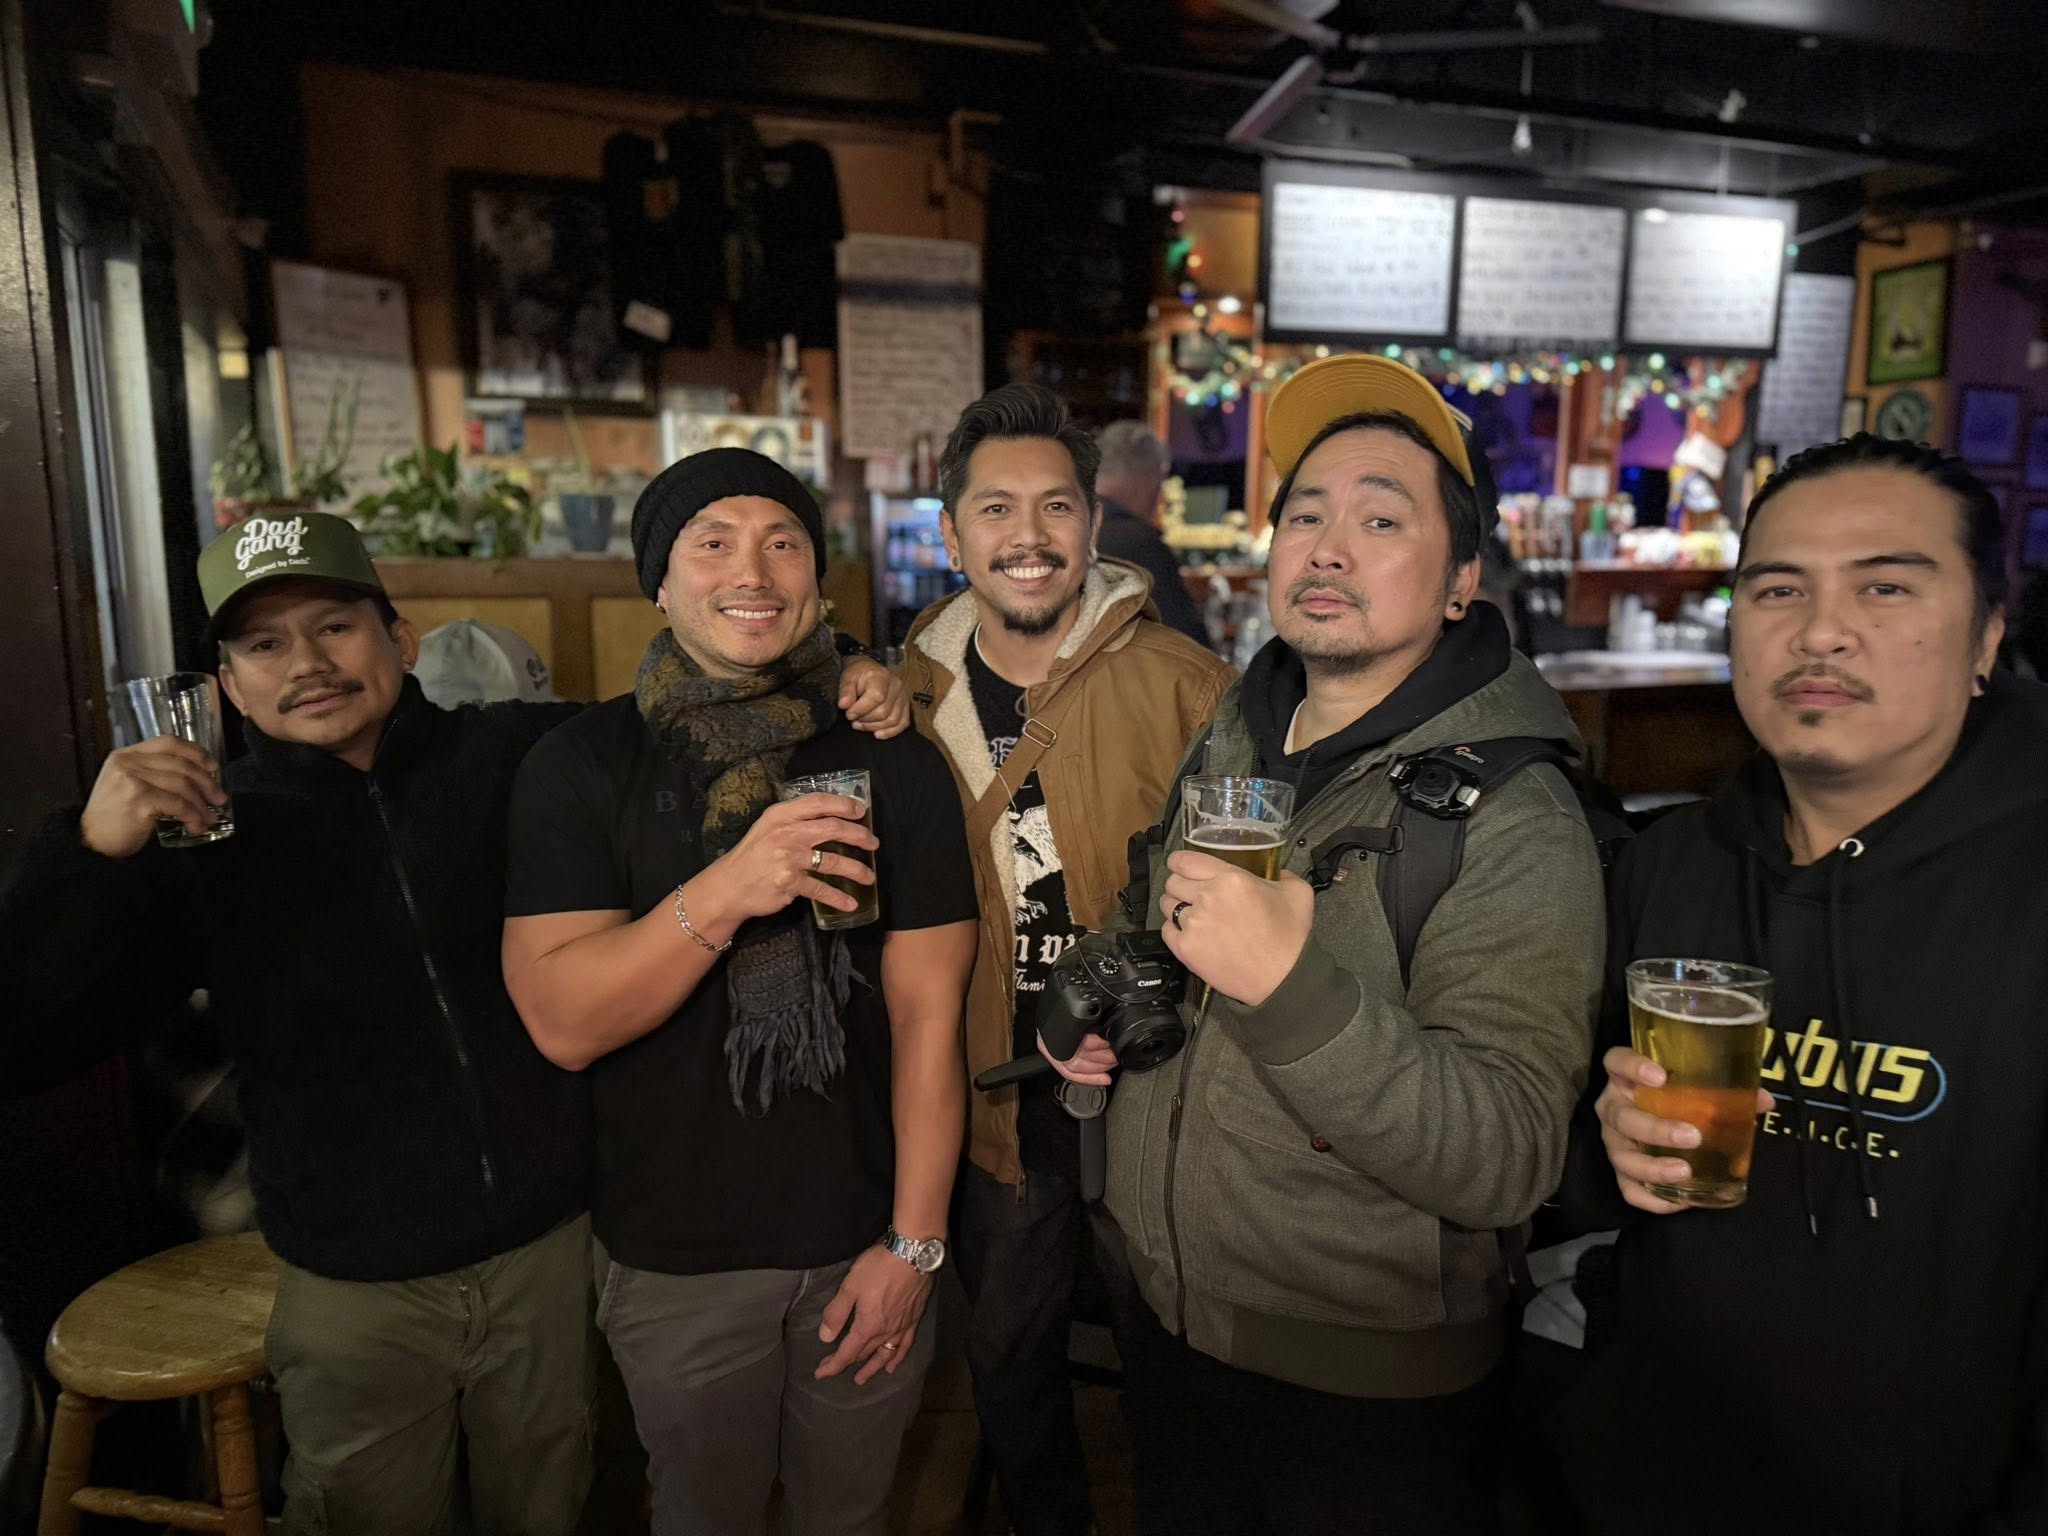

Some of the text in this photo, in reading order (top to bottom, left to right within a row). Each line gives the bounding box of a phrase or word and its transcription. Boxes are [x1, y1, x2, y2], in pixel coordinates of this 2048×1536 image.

[243, 516, 309, 540] Dad
[235, 533, 304, 571] Gang
[277, 560, 288, 568] by
[1137, 978, 1162, 988] Canon
[1760, 1018, 1931, 1104] ubus
